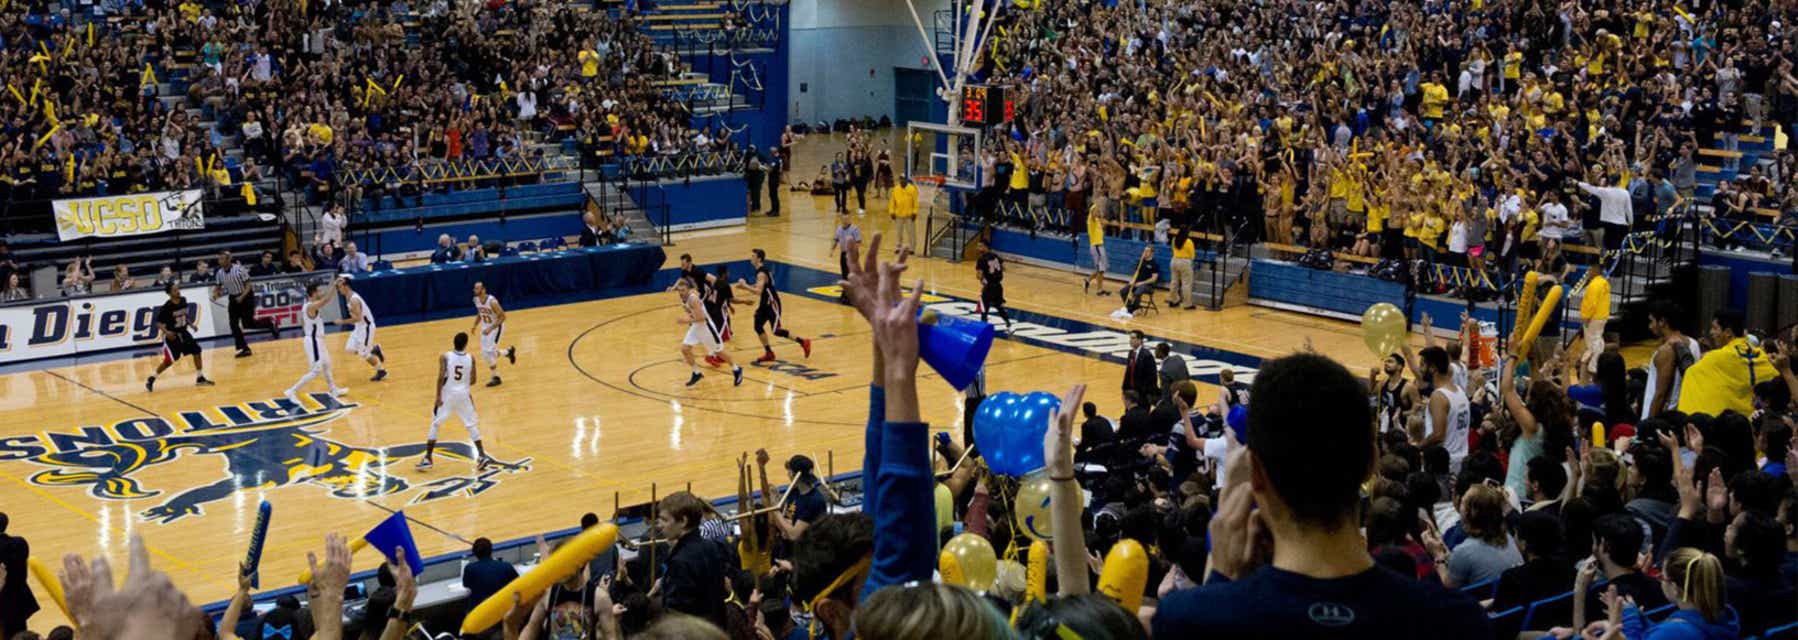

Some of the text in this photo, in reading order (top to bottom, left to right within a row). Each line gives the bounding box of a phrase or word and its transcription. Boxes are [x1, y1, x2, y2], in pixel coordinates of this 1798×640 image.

[963, 100, 984, 122] 35
[68, 195, 163, 235] UCSD
[454, 365, 464, 381] 5
